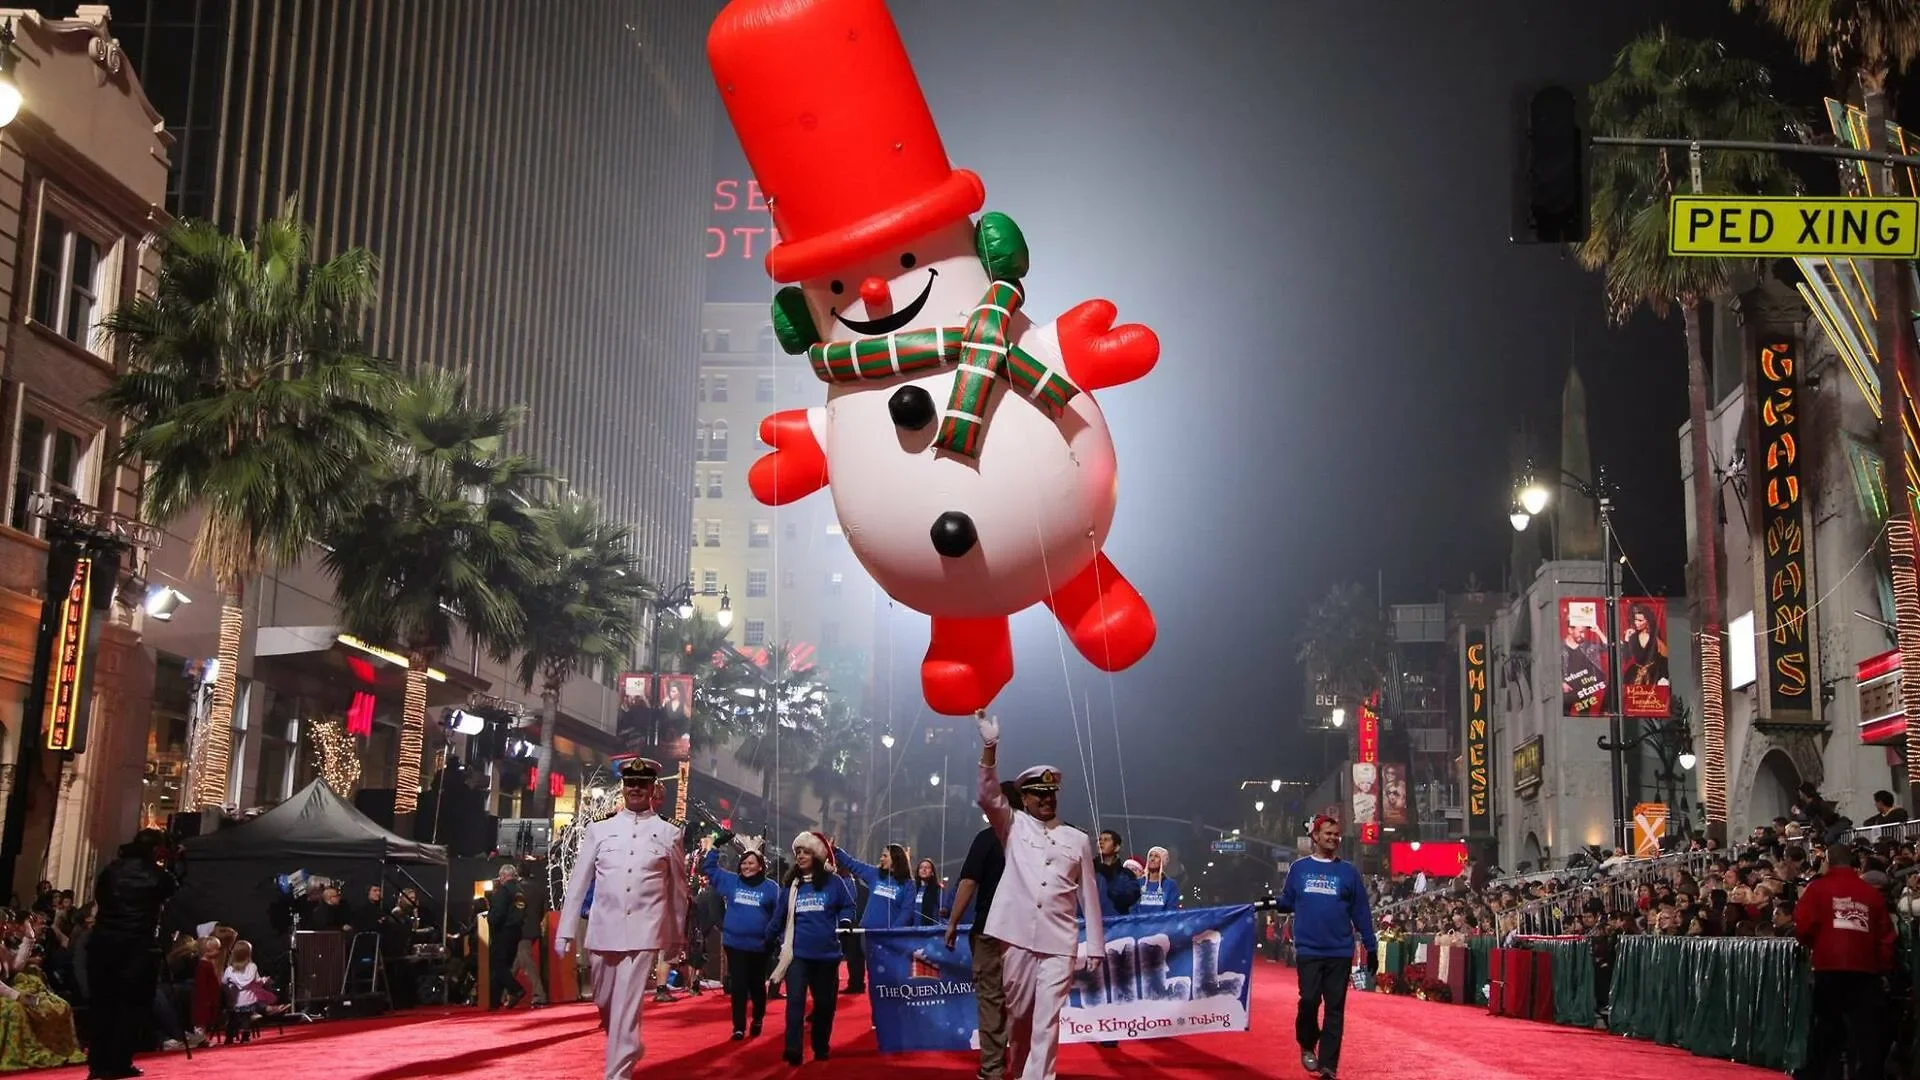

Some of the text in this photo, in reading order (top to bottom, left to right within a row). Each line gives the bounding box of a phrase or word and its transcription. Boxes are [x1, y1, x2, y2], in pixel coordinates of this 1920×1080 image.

[1689, 208, 1900, 246] PED XING
[1761, 343, 1805, 697] GRAUMANS
[1565, 668, 1588, 682] where
[1577, 681, 1606, 699] stars
[1574, 696, 1599, 711] are
[1468, 643, 1487, 815] CHINESE
[1069, 1020, 1093, 1035] Ice
[1097, 1016, 1172, 1038] Kingdom
[1188, 1013, 1231, 1027] Tubing
